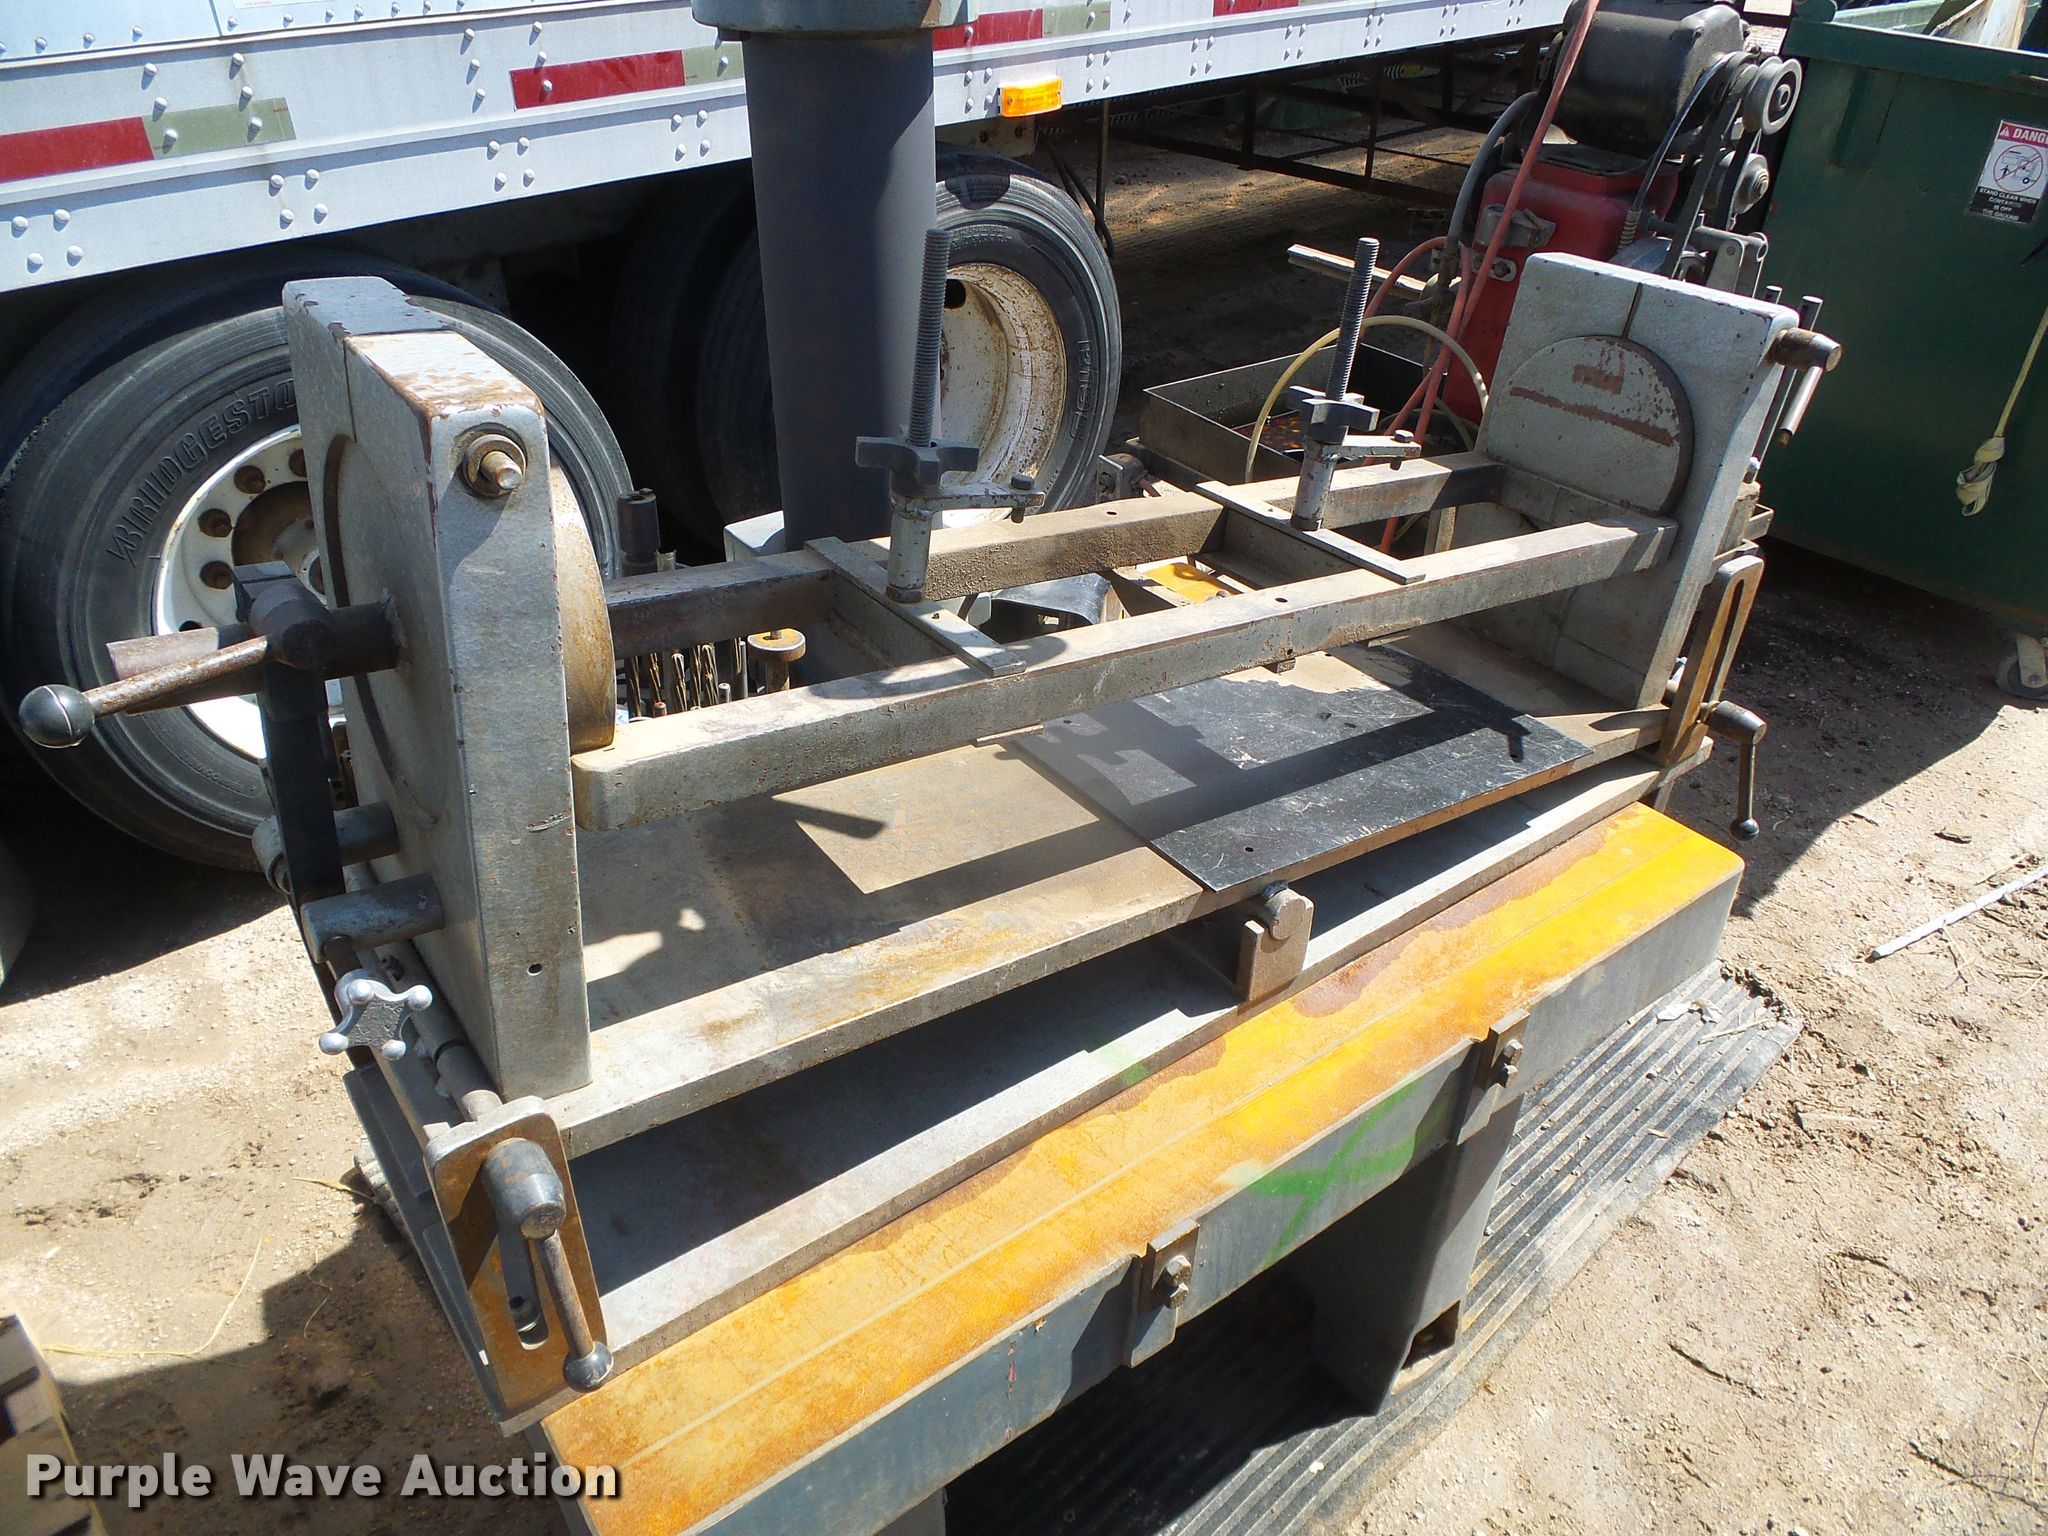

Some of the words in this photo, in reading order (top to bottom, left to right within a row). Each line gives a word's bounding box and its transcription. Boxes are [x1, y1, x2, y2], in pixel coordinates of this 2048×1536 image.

[1979, 187, 1999, 197] STAND
[1999, 192, 2019, 201] CLEAR
[1988, 196, 2022, 208] CONTA
